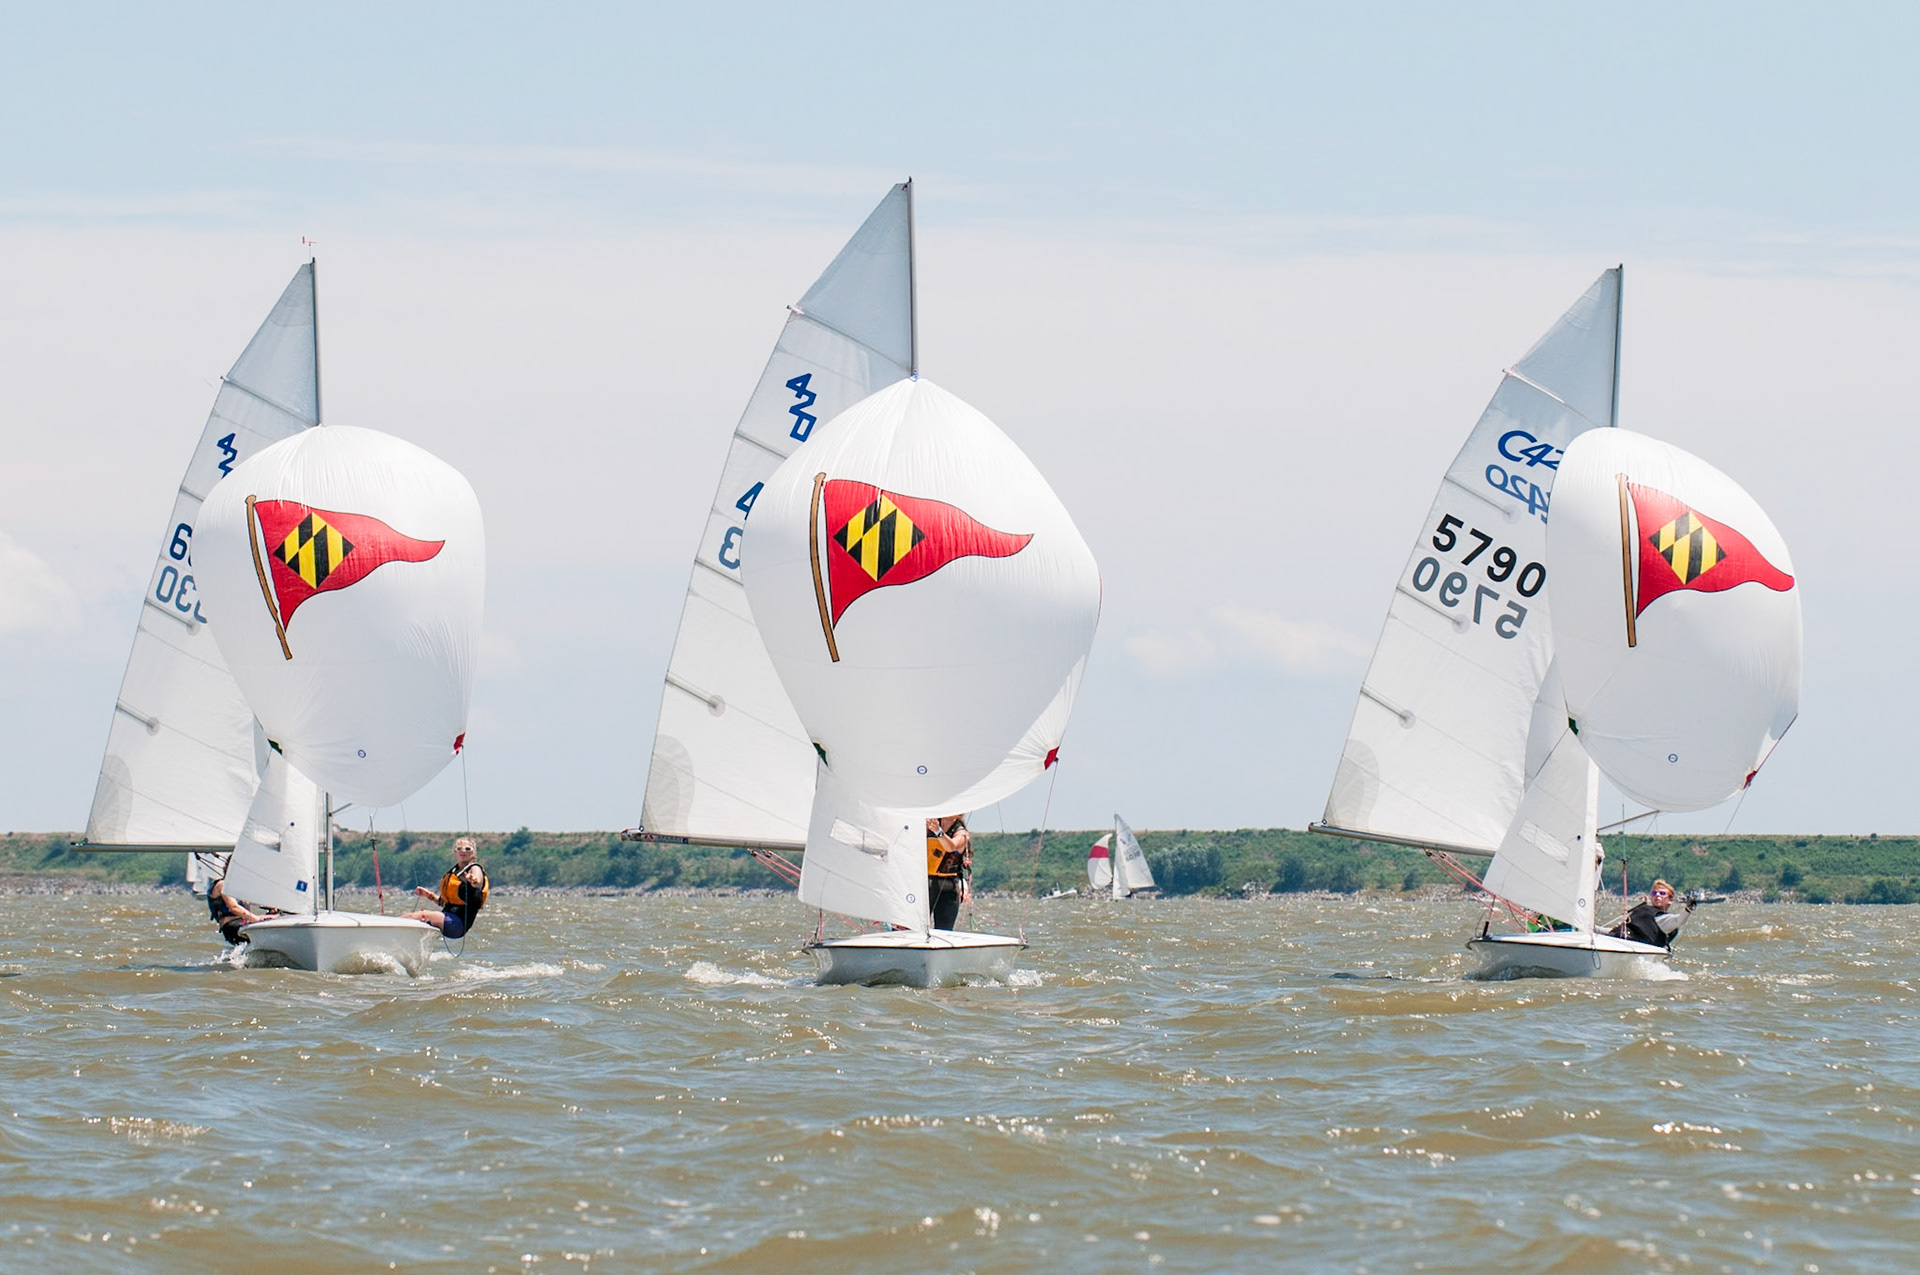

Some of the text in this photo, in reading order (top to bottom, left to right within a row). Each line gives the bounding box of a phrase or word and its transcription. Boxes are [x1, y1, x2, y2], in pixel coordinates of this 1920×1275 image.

[785, 373, 817, 442] 420
[216, 433, 238, 480] 42
[1432, 513, 1547, 598] 5790
